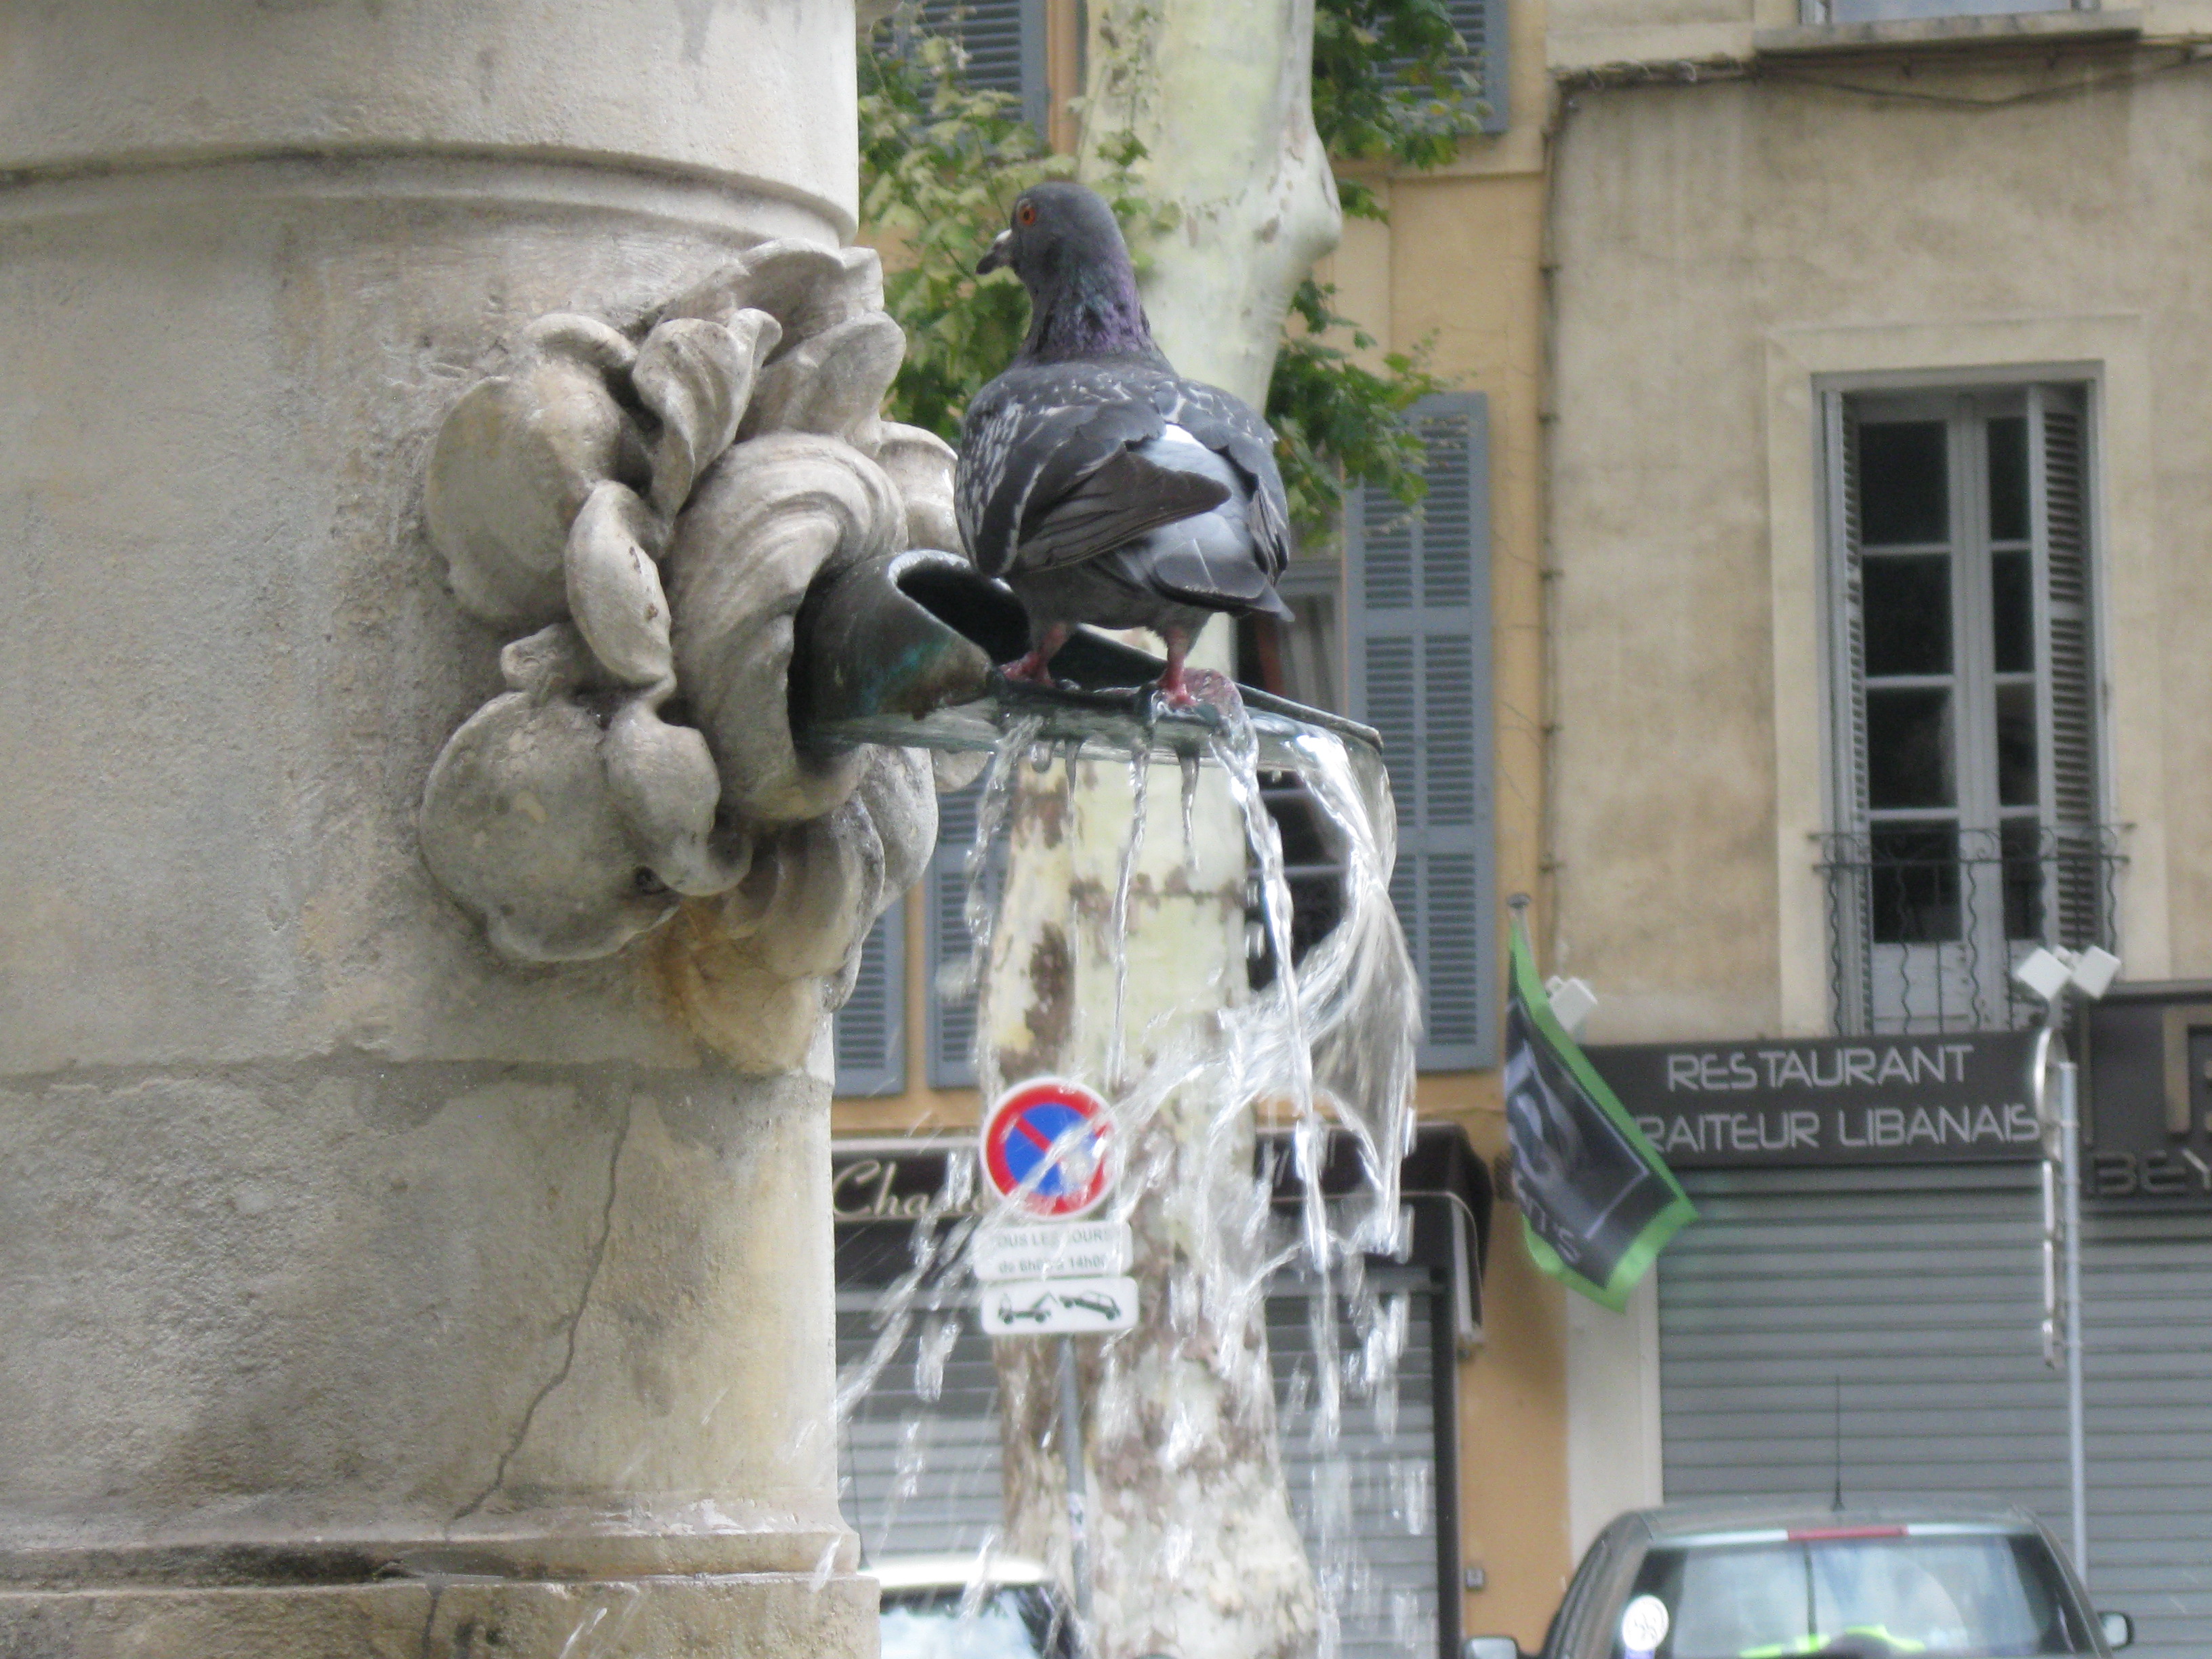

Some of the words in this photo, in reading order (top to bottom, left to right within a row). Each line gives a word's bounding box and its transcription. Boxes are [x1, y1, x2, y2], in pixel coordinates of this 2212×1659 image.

[1667, 1044, 1974, 1092] RESTAURANT
[1635, 1110, 1820, 1152] RAITEUR
[1837, 1103, 2041, 1146] LIBANAIS
